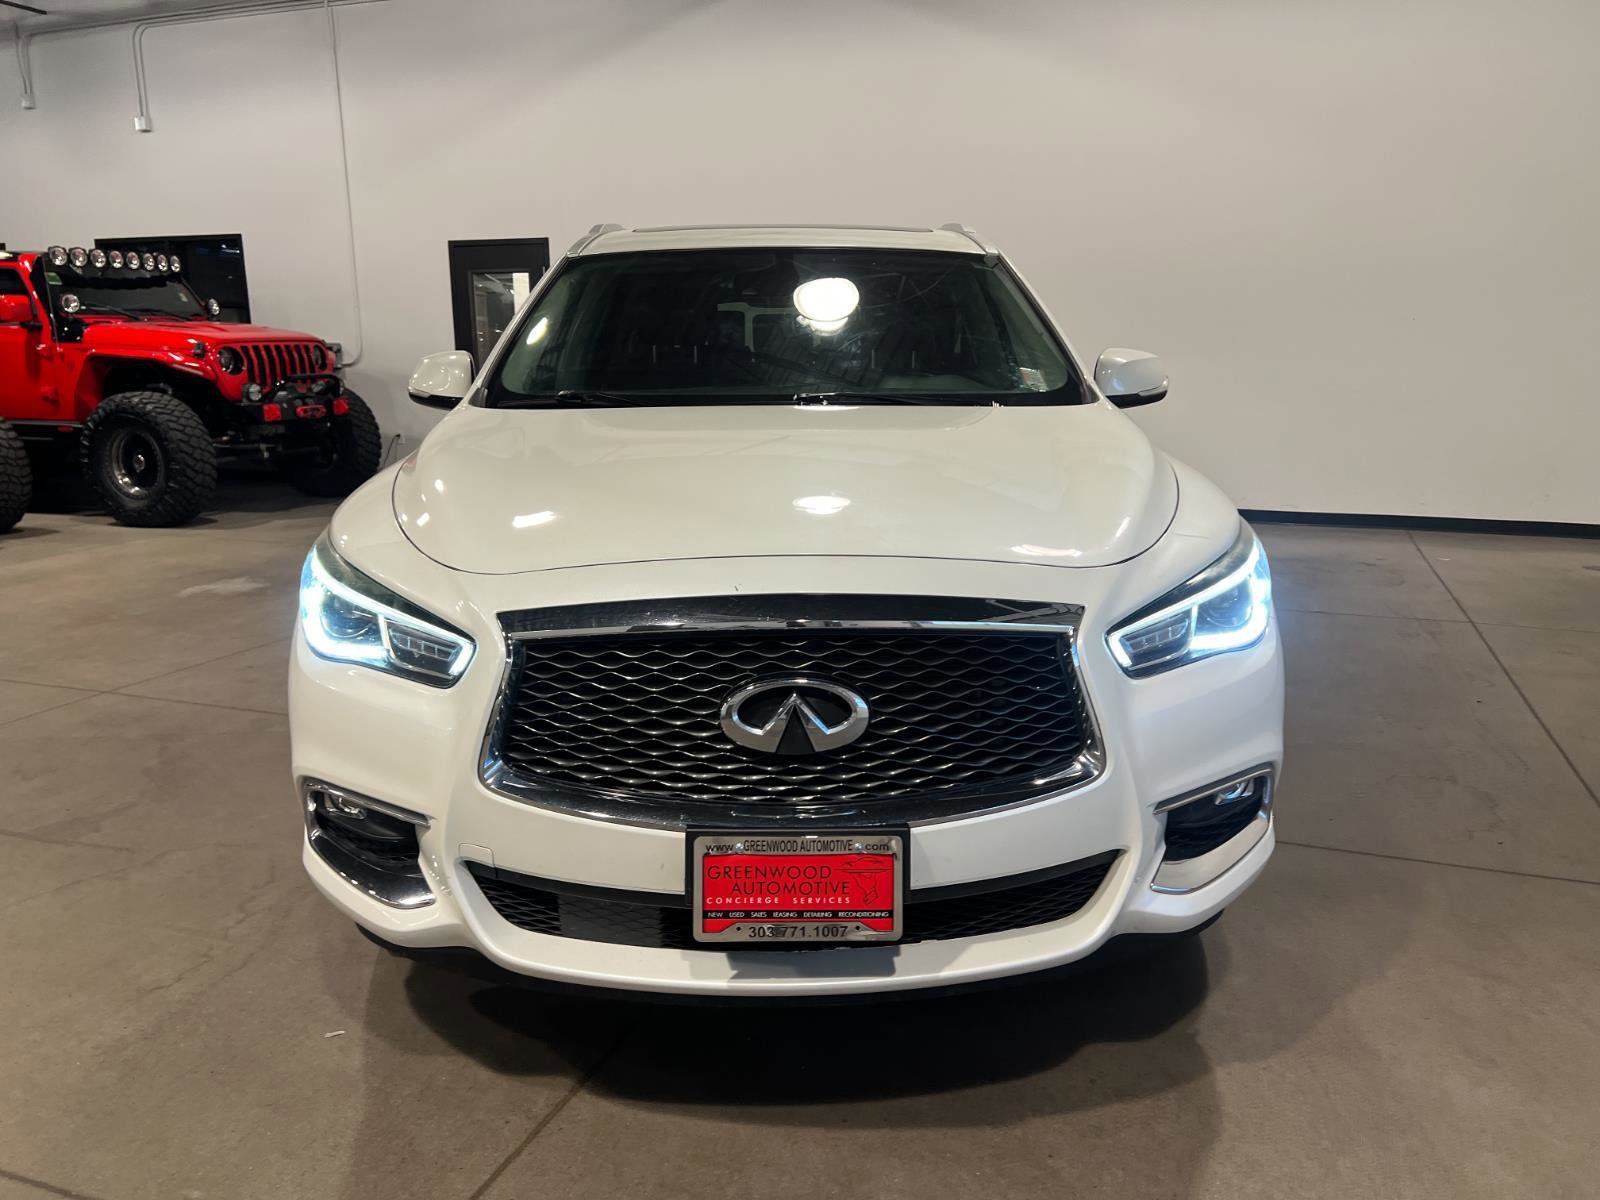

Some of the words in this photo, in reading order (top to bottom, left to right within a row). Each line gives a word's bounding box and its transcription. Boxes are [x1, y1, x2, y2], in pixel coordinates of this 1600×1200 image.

[705, 843, 734, 852] www
[743, 840, 798, 852] GREENWOOD
[800, 840, 853, 851] AUTOMOTIVE
[707, 866, 832, 880] GREENWOOD
[731, 882, 850, 895] AUTOMOTIVE
[706, 896, 780, 904] CONCIERGE
[792, 896, 850, 904] SERVICES
[748, 926, 848, 938] 303771.1007
